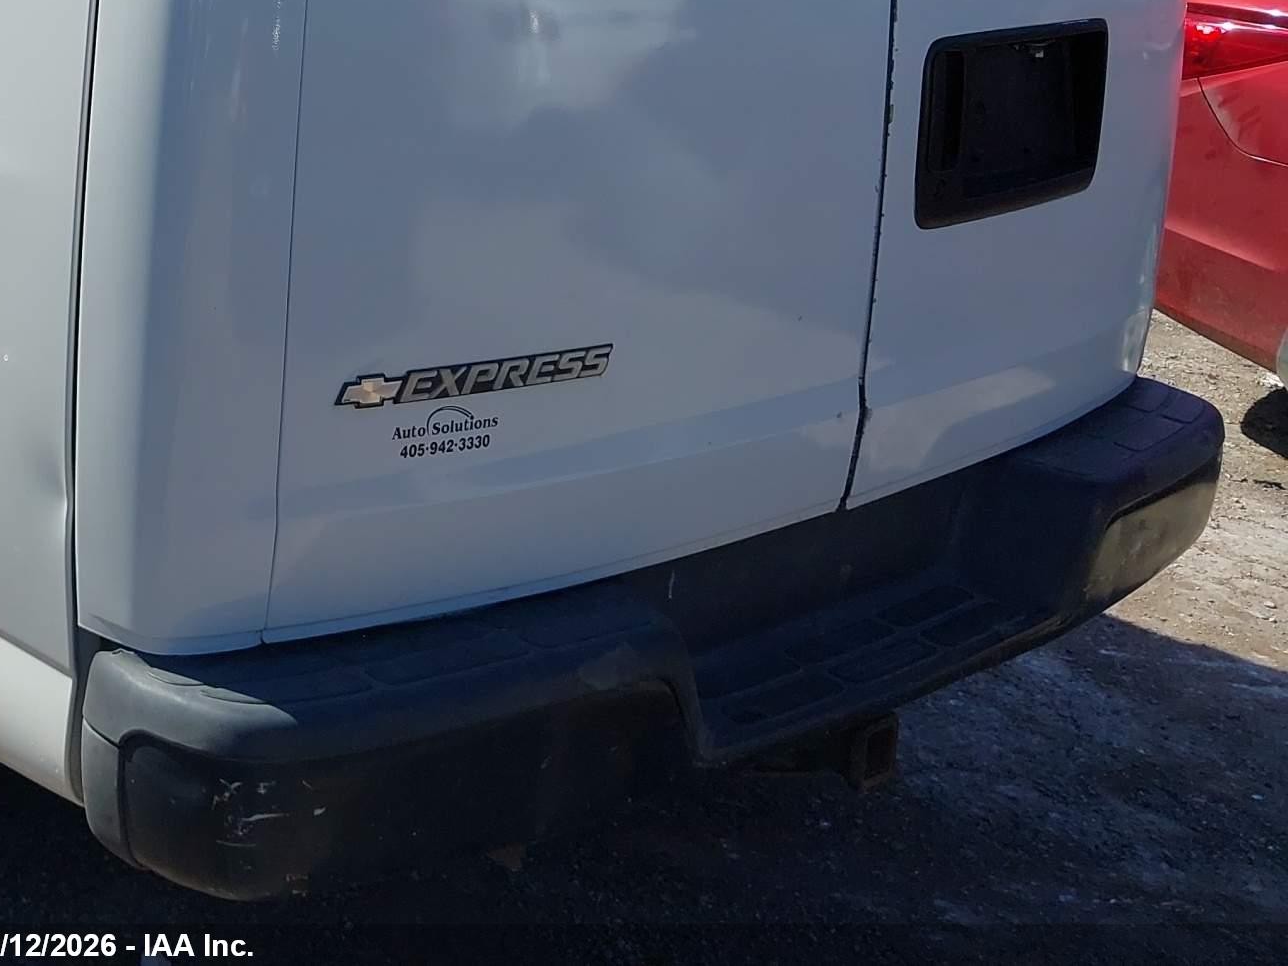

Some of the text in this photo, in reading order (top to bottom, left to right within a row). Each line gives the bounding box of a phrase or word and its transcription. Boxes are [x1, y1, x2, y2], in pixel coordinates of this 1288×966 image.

[400, 345, 612, 403] EXPRESS
[392, 416, 498, 440] Auto Solutions
